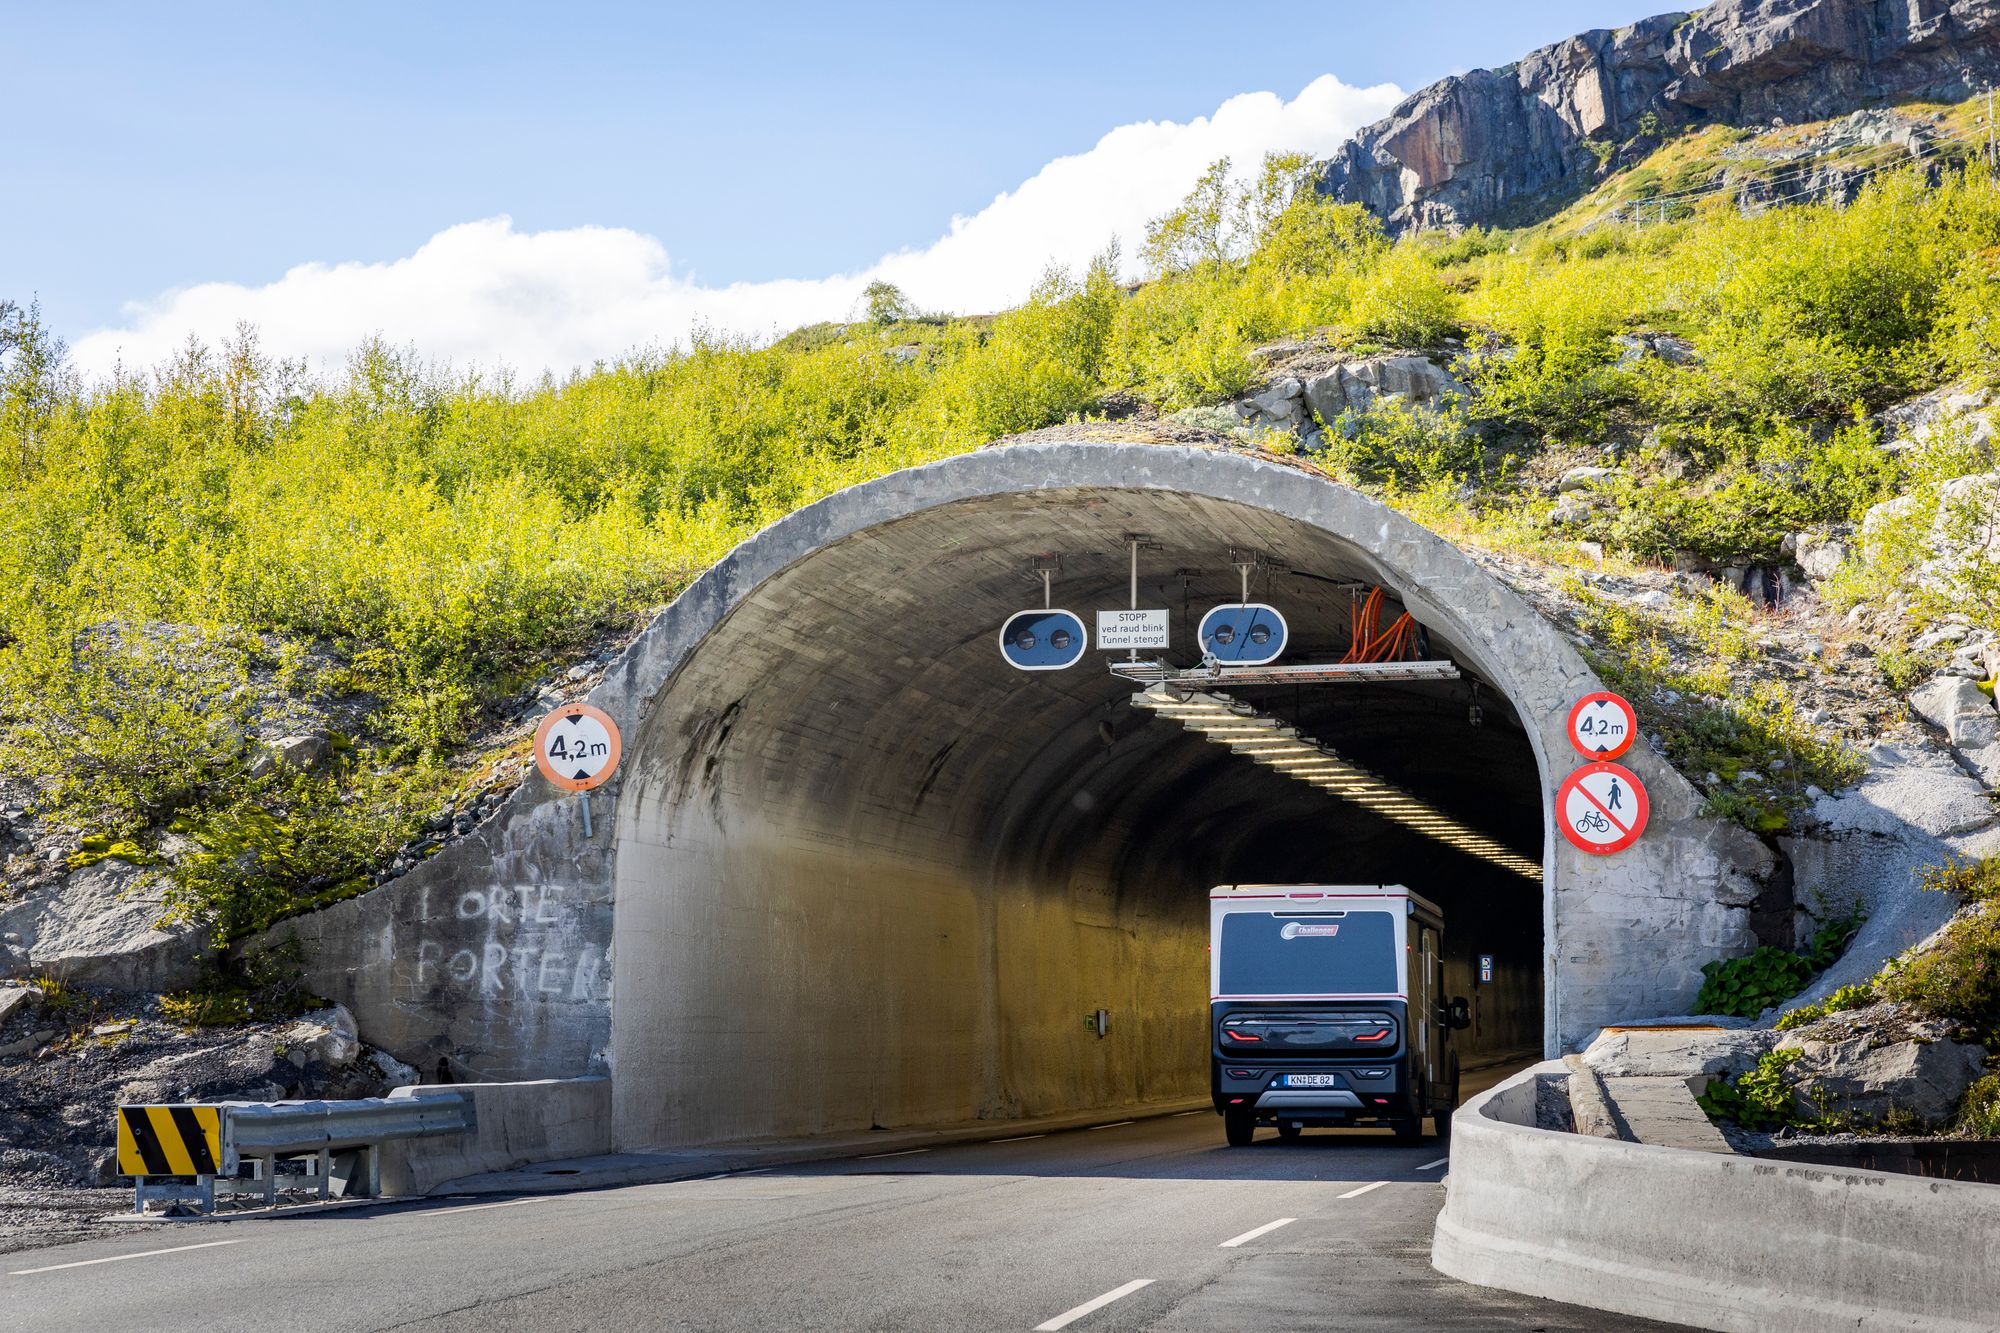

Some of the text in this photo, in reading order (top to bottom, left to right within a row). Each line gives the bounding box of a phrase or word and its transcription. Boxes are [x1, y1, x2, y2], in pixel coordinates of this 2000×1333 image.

[1118, 613, 1148, 622] STOPP
[1101, 624, 1164, 633] ved raud blink
[1101, 635, 1164, 645] Tunnel stengd
[1290, 1075, 1331, 1085] KN DE 82
